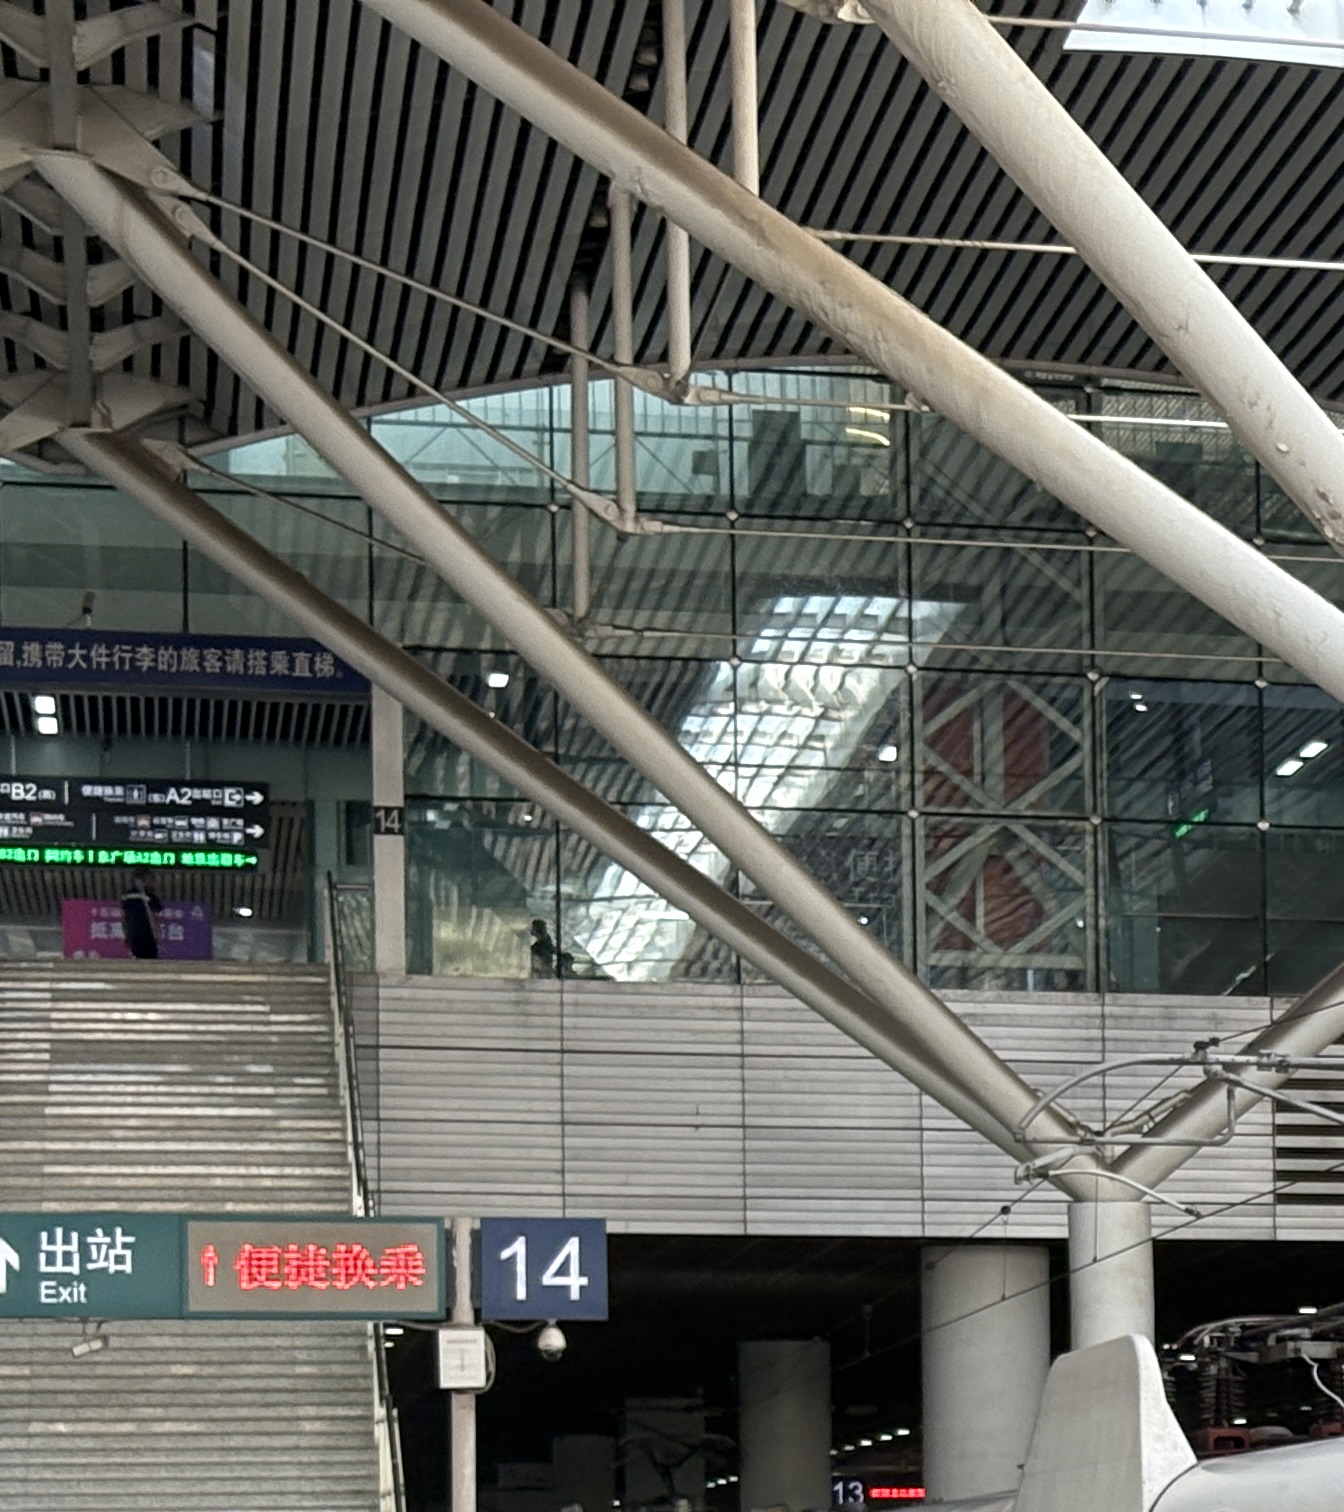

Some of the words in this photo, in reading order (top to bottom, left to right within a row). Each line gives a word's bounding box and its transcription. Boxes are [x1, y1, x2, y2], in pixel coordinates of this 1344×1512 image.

[11, 783, 37, 801] B2
[166, 787, 192, 804] A2
[375, 809, 400, 832] 14
[39, 1227, 136, 1275] 出站
[234, 1242, 427, 1290] 便捷换乘
[500, 1236, 589, 1301] 14
[40, 1281, 87, 1304] Exit
[833, 1481, 864, 1505] 13
